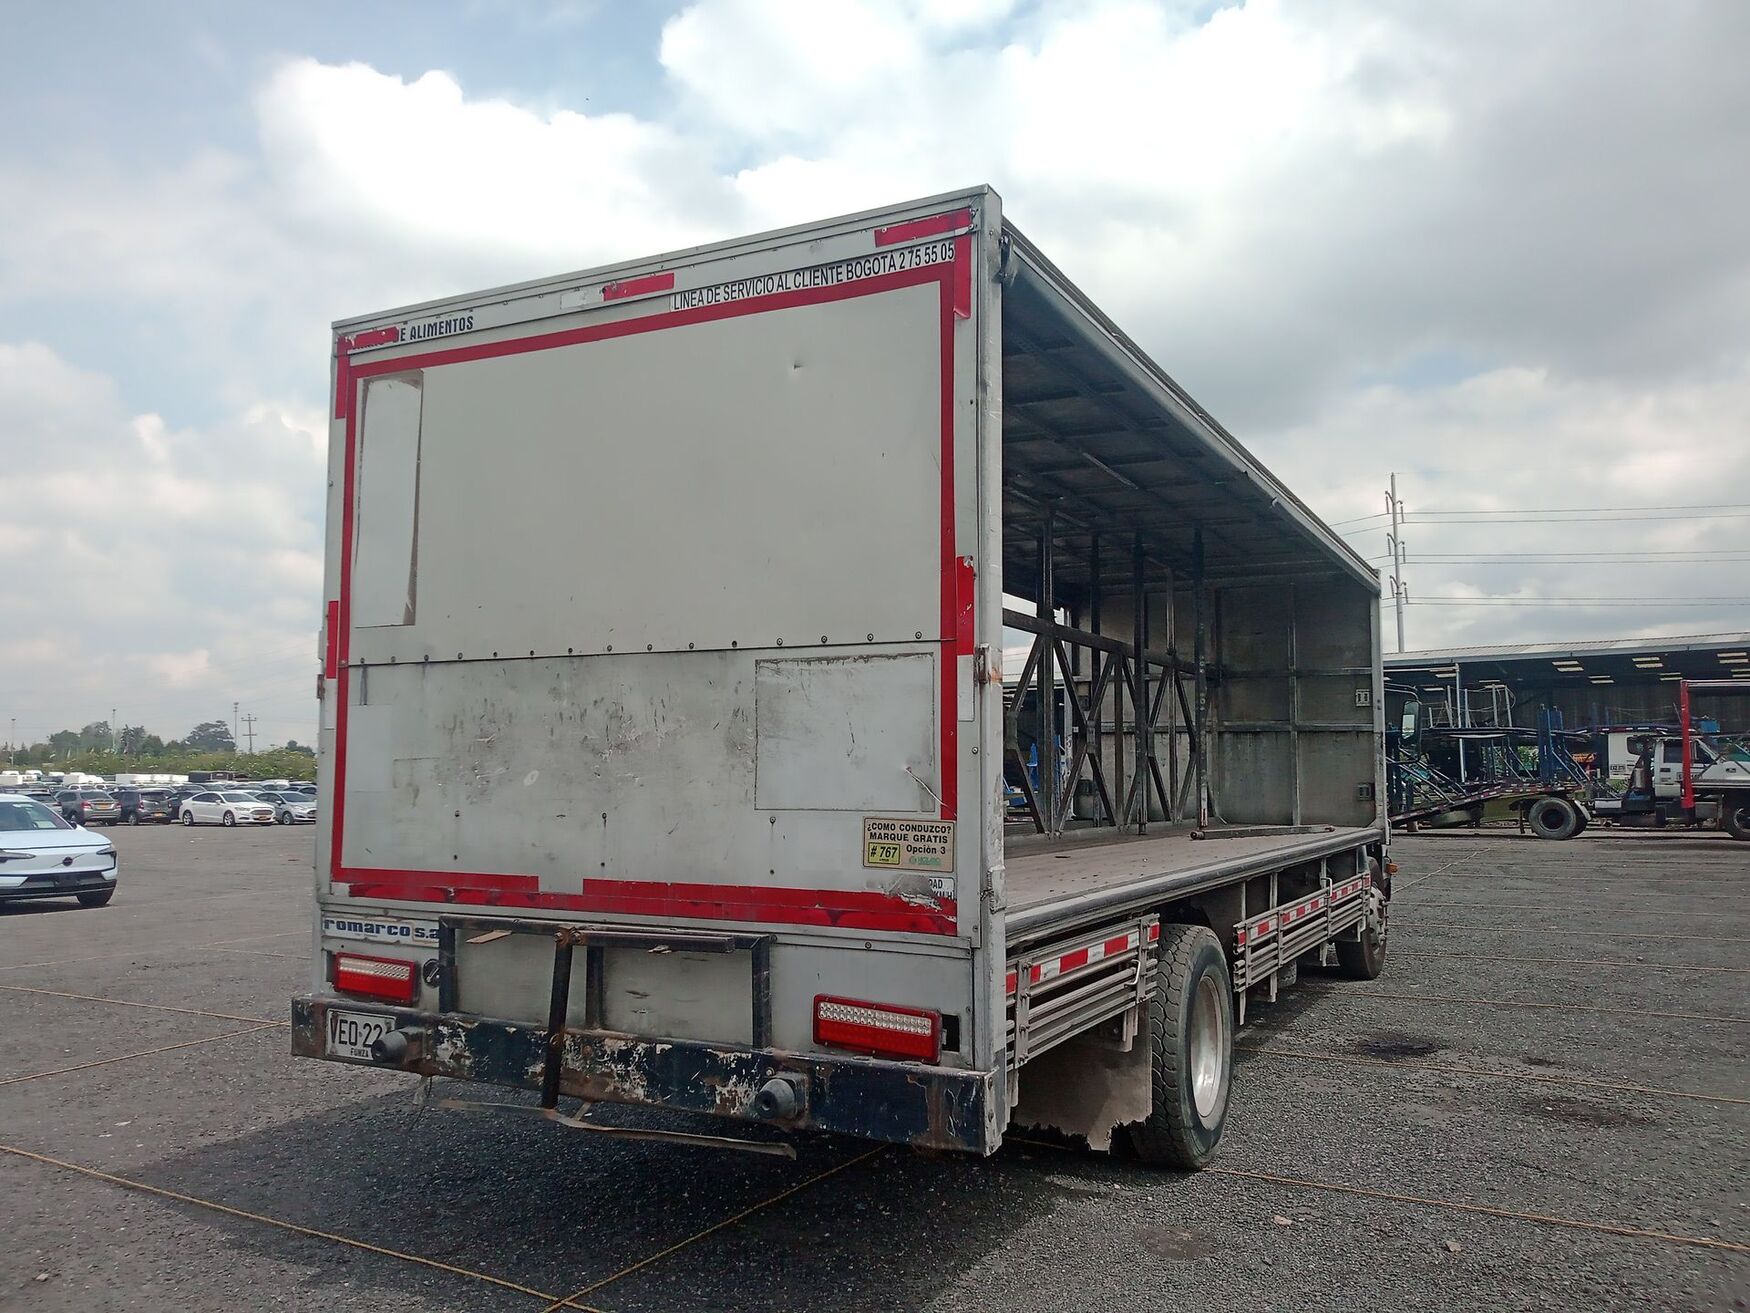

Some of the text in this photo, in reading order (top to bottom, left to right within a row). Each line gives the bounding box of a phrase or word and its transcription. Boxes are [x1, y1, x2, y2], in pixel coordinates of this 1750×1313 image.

[674, 288, 705, 310] LINEA
[706, 286, 721, 304] DE
[723, 276, 775, 301] SERVICIO
[776, 273, 791, 292] AL
[793, 265, 843, 289] CLIENTE
[899, 251, 906, 270] 2
[924, 245, 938, 264] 55
[940, 242, 954, 261] 05
[409, 316, 474, 340] ALIMENTOS
[899, 824, 951, 834] CONDUZCO?
[869, 832, 948, 844] MARQUE GRATIS
[879, 846, 898, 859] 767
[940, 846, 946, 855] 3
[324, 919, 411, 937] romarco
